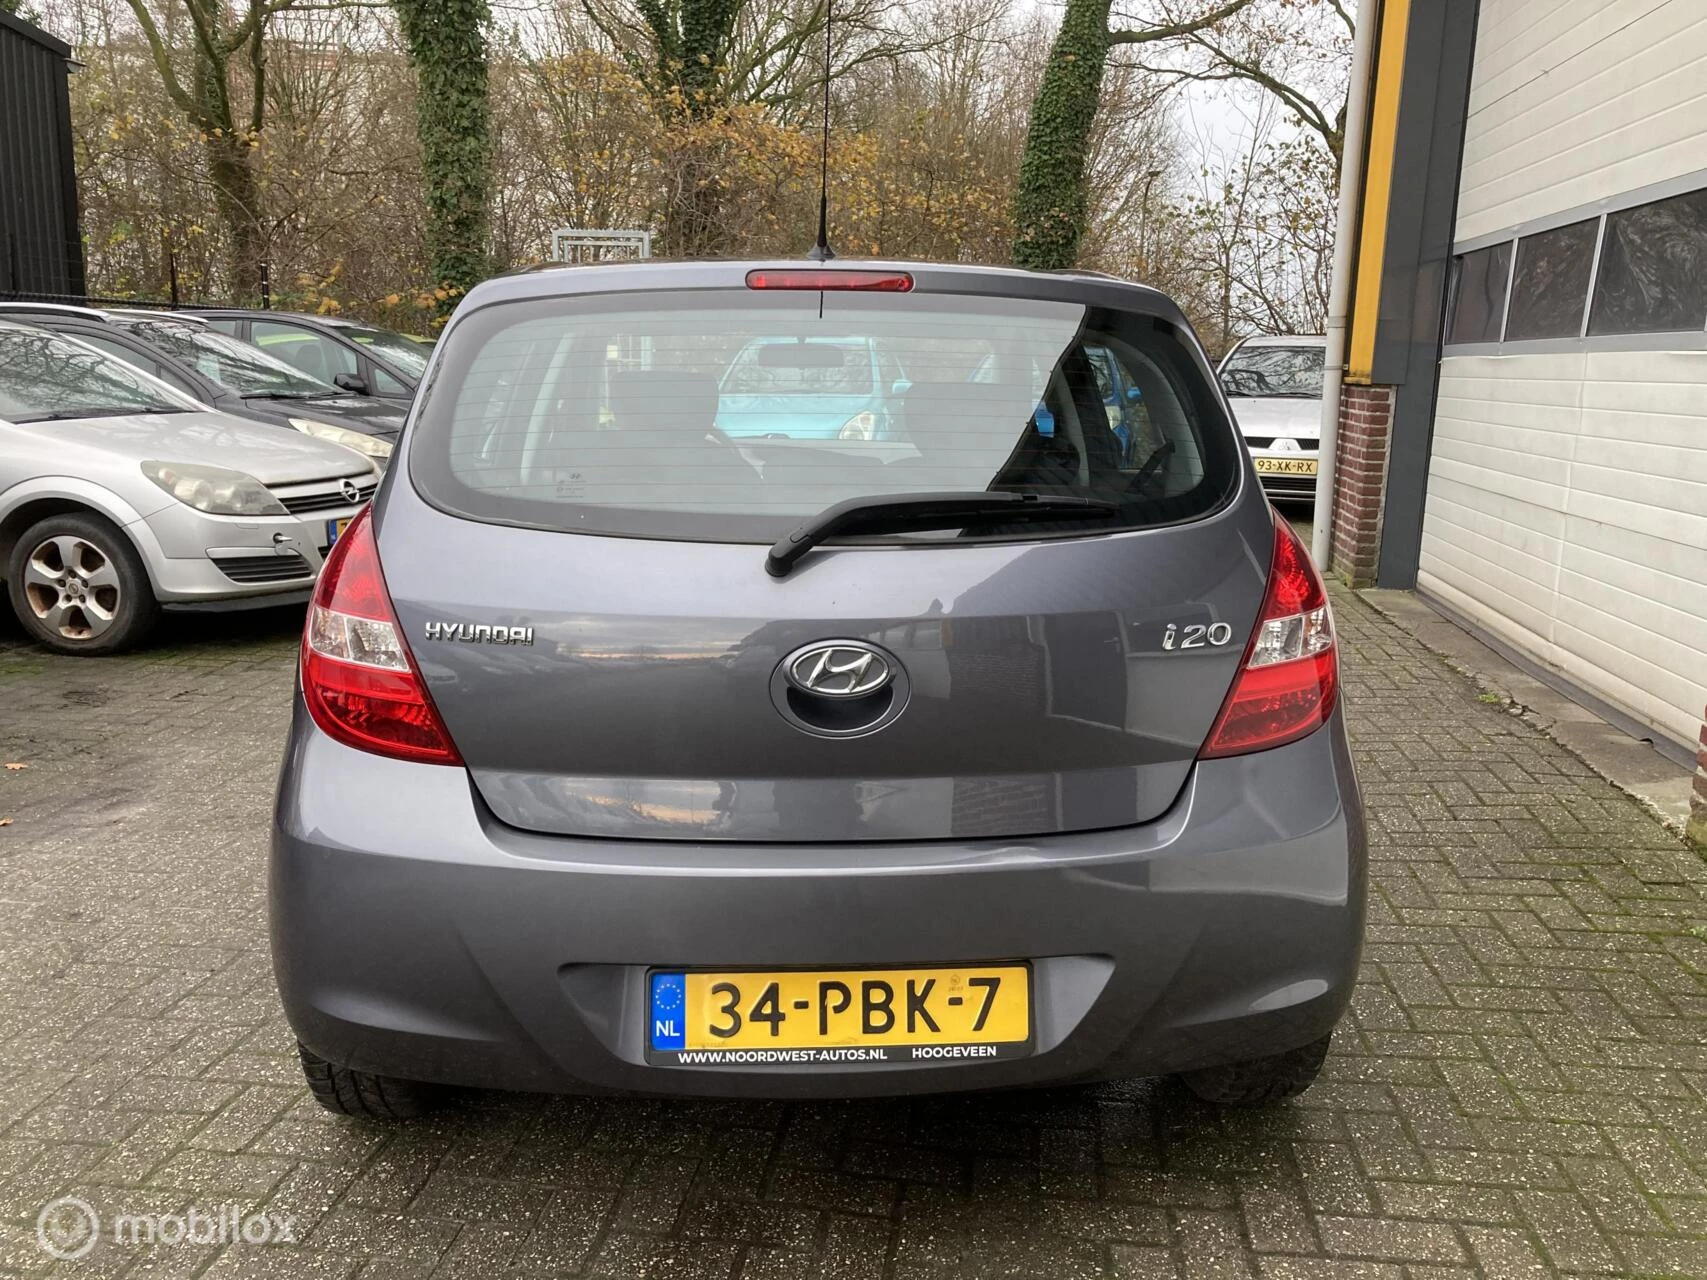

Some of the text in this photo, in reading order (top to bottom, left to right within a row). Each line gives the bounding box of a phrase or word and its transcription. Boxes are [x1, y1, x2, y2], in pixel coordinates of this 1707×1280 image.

[1257, 460, 1313, 473] 93-XK-RX
[425, 622, 534, 646] HYUNDAI
[1162, 622, 1232, 651] i20
[709, 977, 1001, 1039] 34-PBK-7
[655, 1020, 681, 1037] NL
[678, 1046, 997, 1064] WWW.NOORDWEST-AUTOS.NL HOOGEVEEN
